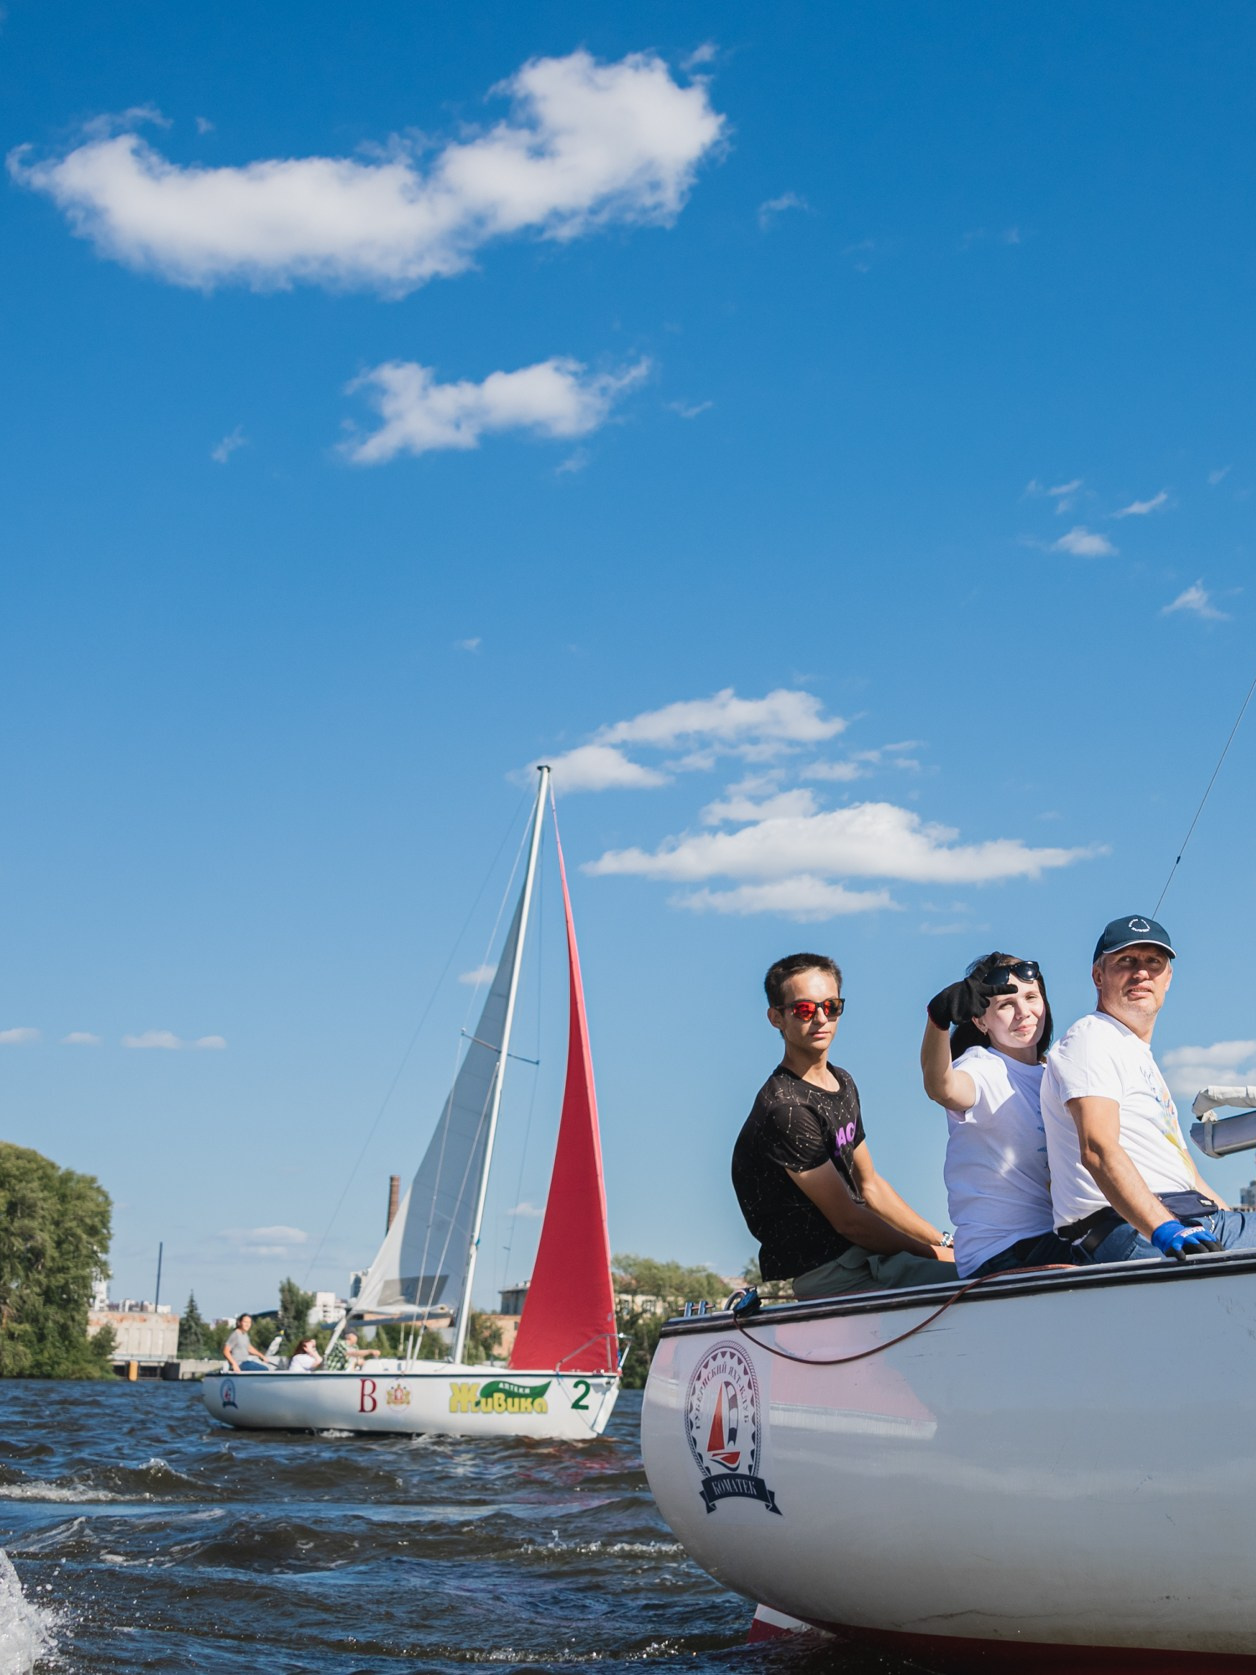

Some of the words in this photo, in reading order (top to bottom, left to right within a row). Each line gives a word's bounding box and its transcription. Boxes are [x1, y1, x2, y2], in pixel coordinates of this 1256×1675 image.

[449, 1383, 548, 1414] Живика
[570, 1379, 591, 1411] 2
[712, 1478, 757, 1497] КОМАТЕК
